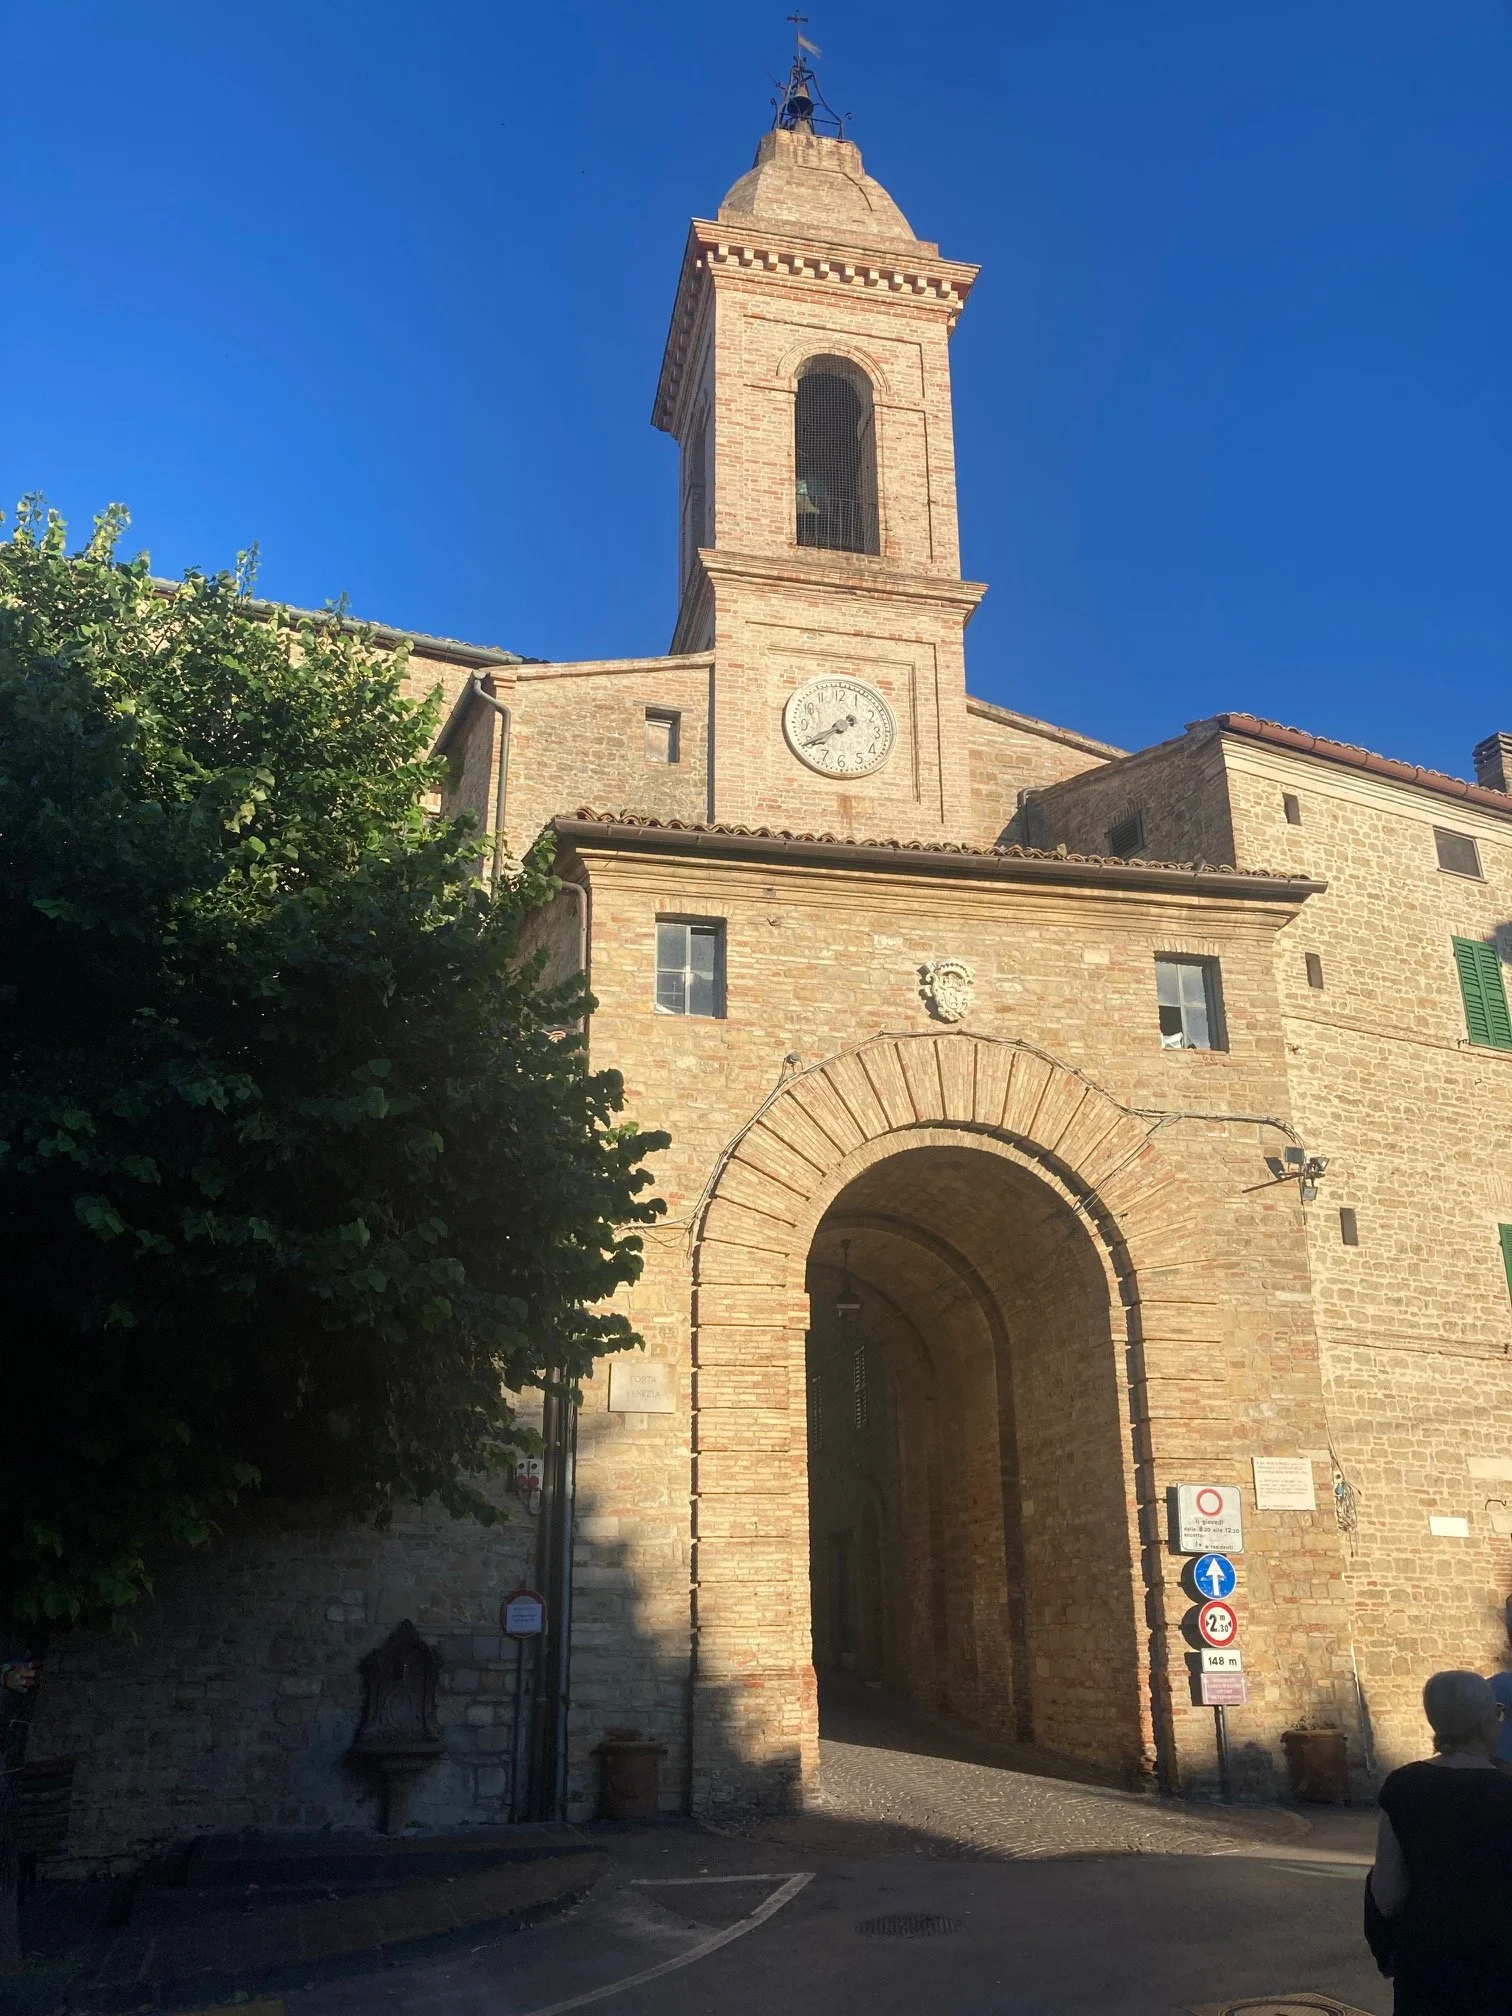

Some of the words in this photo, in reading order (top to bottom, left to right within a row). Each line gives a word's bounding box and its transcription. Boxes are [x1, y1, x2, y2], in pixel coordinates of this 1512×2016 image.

[818, 692, 824, 703] 11
[835, 690, 846, 702] 12
[804, 702, 814, 714] 10
[867, 710, 875, 723] 2
[801, 719, 808, 731] 9
[874, 727, 881, 739] 3
[868, 743, 876, 755] 4
[821, 749, 829, 762] 7
[837, 755, 846, 768] 6
[855, 753, 863, 764] 5
[629, 1375, 657, 1384] PORTA
[626, 1389, 660, 1398] VENEZIA
[1208, 1656, 1225, 1665] 148
